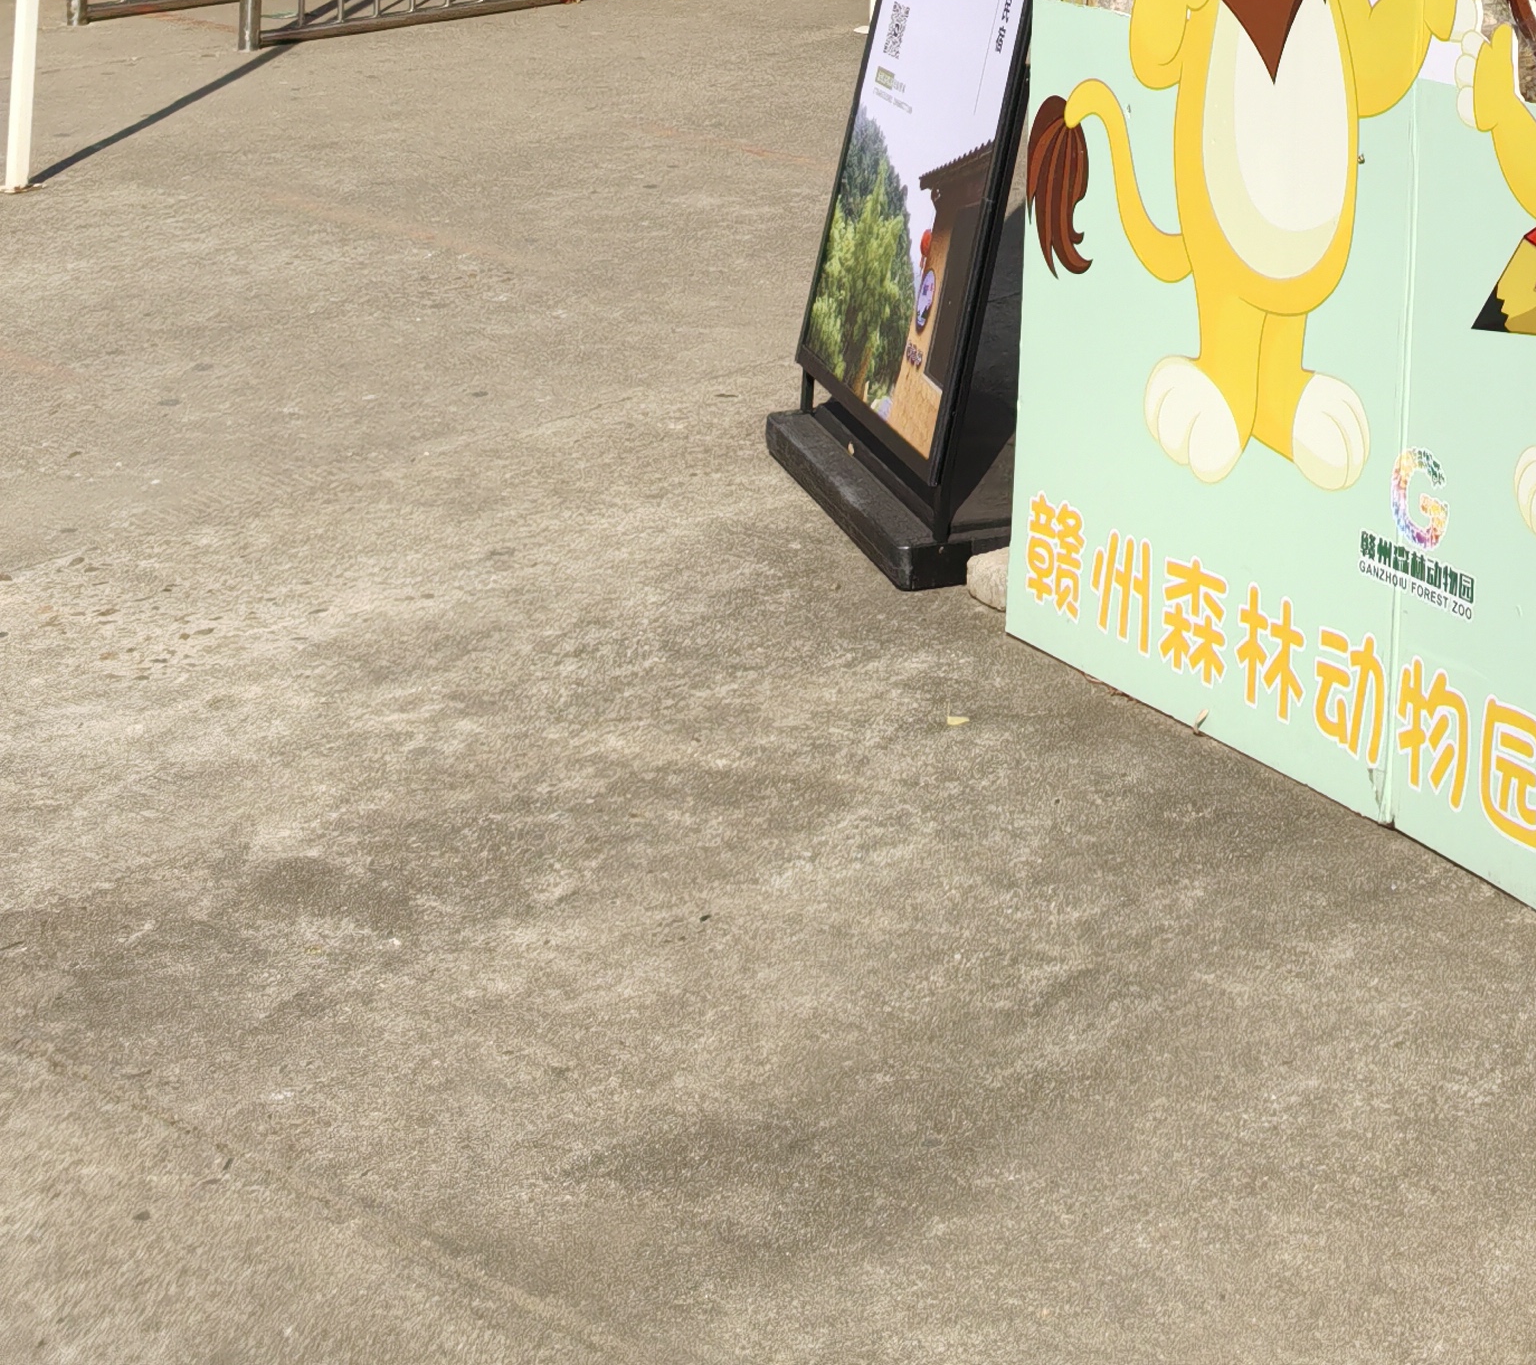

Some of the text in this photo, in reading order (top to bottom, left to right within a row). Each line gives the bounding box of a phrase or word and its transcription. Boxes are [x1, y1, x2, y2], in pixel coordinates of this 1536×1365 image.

[1359, 560, 1472, 620] GANZHOU FOREST ZOO
[1360, 530, 1475, 604] 赣州森林动物园
